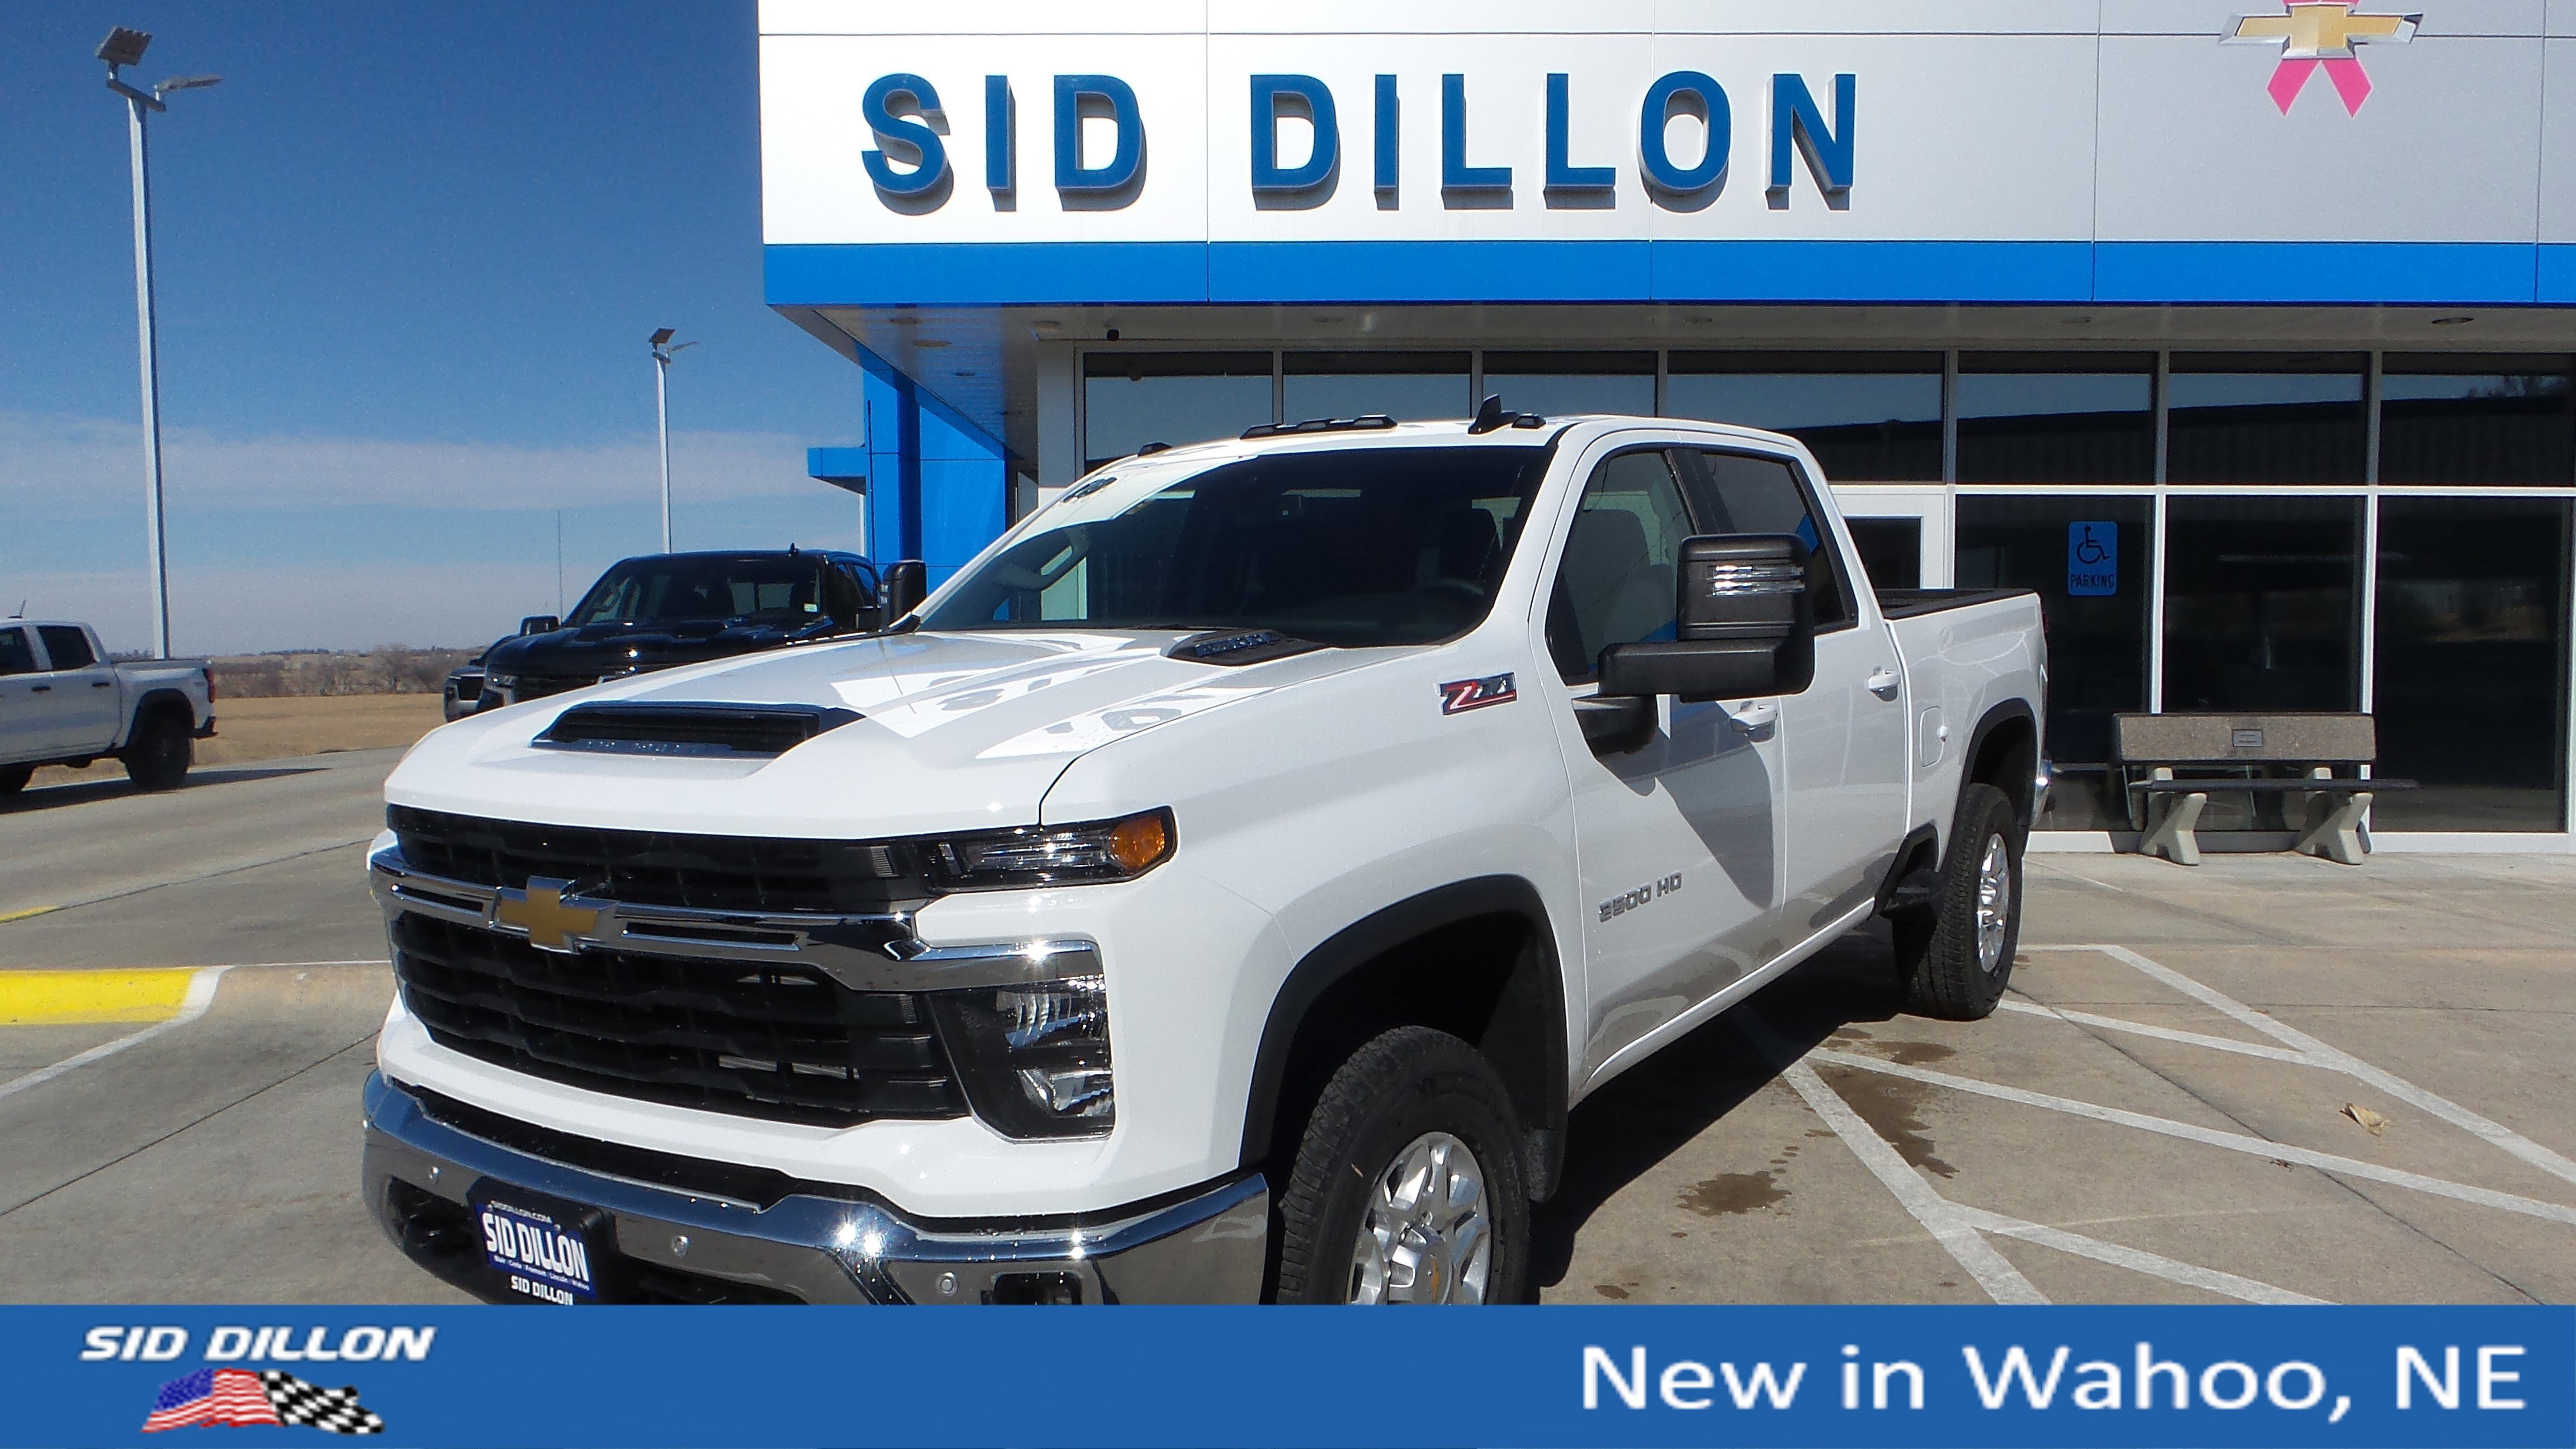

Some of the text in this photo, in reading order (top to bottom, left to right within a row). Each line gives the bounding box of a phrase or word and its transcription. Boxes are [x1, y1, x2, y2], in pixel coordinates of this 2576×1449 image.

[861, 70, 1857, 193] SID DILLON
[2070, 573, 2115, 588] PARKING
[1656, 872, 1682, 897] HD
[482, 1212, 517, 1258] SID
[516, 1223, 590, 1282] DILLON
[510, 1275, 574, 1305] SID DILLON
